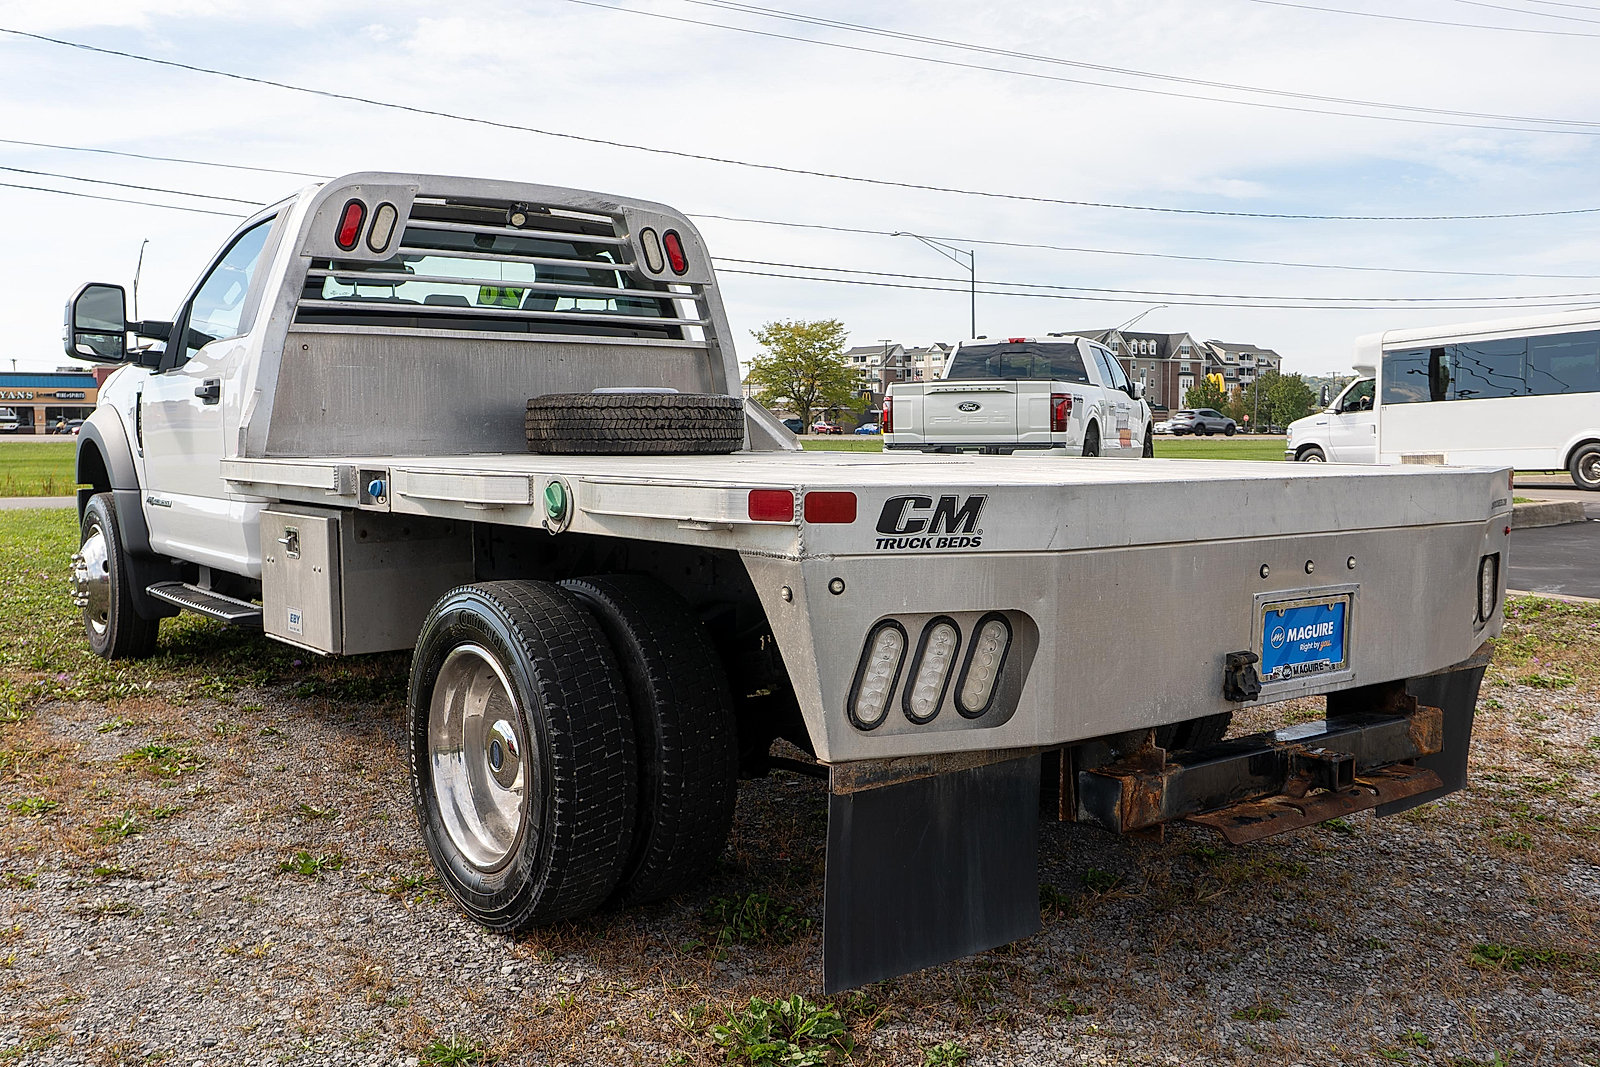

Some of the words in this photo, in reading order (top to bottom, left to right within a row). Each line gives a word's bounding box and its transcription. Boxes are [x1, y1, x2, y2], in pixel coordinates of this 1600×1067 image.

[928, 415, 1011, 425] F-150
[875, 493, 989, 536] CM
[875, 536, 933, 549] TRUCK
[936, 536, 982, 549] BEDS
[289, 612, 300, 624] EBY
[459, 610, 504, 651] Continental
[1286, 621, 1334, 642] MAGUIRE
[1299, 641, 1314, 652] Right
[1313, 641, 1321, 650] by
[1293, 662, 1324, 675] MAGUIRE
